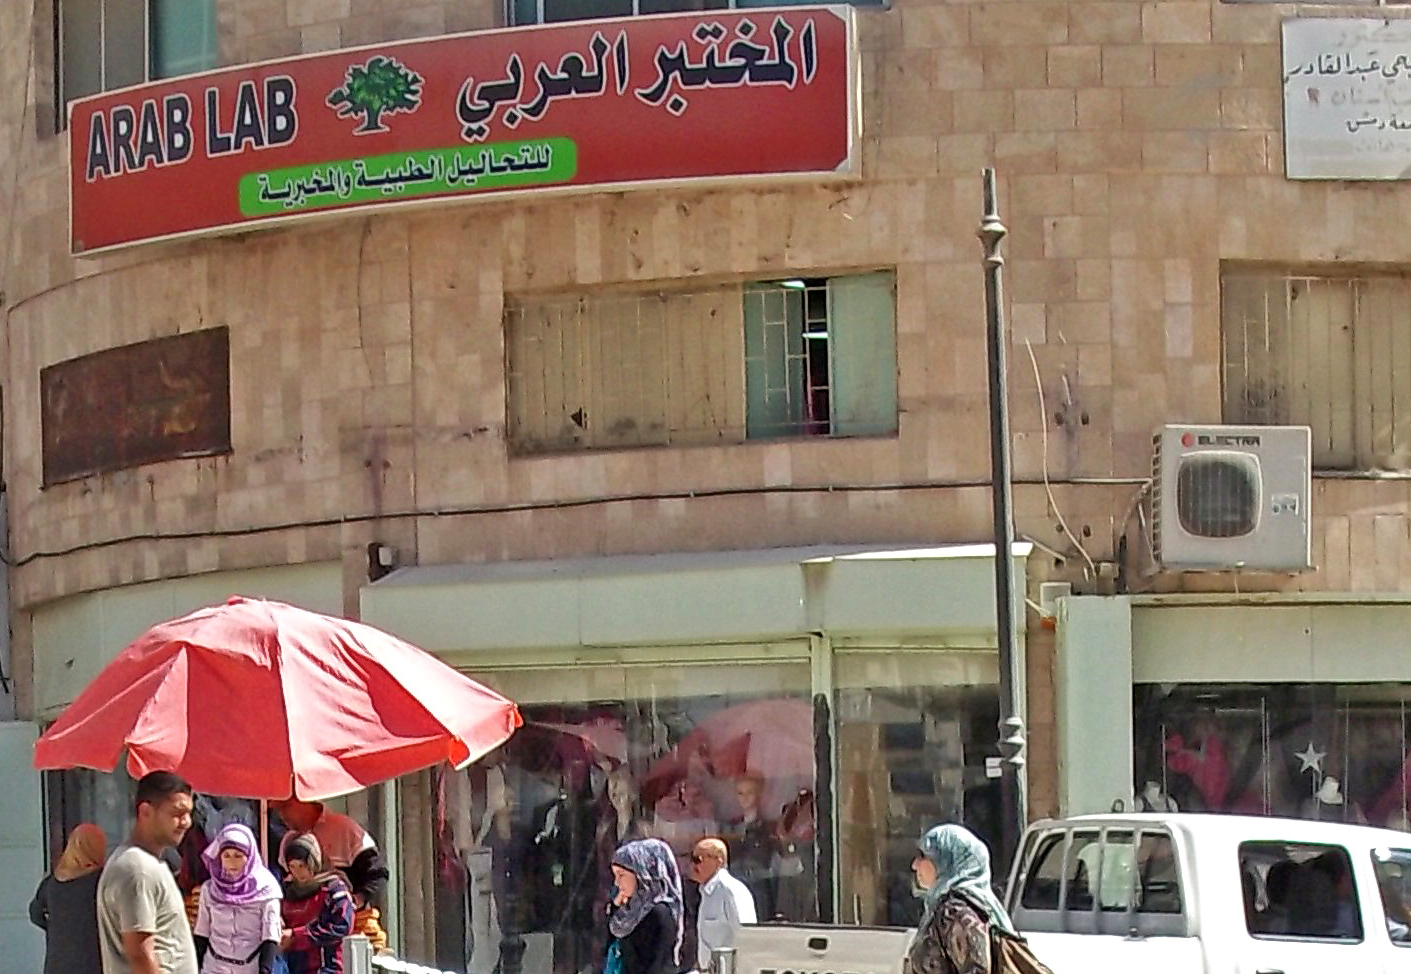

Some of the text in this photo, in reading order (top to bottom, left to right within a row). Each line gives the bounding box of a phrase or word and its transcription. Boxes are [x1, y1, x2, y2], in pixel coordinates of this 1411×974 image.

[456, 15, 819, 142] المختبر العربي
[87, 76, 297, 182] ARAB LAB
[258, 144, 553, 209] للتحاليل الطبية والمخبرية
[1197, 435, 1261, 447] ELECTRA
